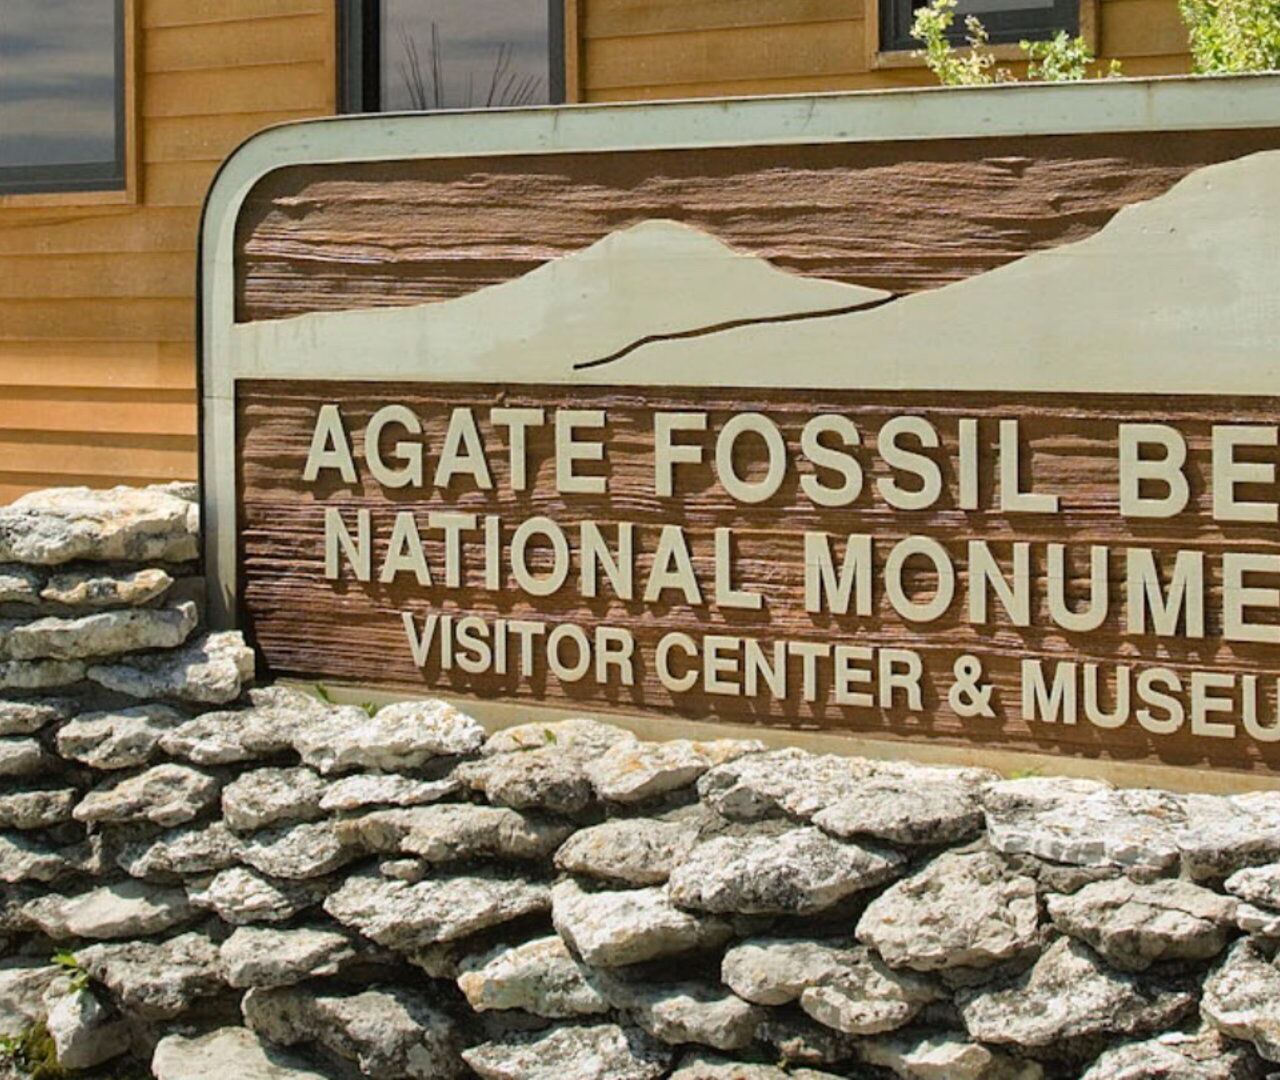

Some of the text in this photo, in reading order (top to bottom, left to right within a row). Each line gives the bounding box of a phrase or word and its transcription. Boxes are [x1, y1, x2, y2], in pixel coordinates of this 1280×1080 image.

[302, 404, 607, 495] AGATE
[653, 411, 1060, 514] FOSSIL
[323, 507, 763, 610] NATIONAL
[401, 611, 634, 687] VISITOR
[654, 631, 925, 713] CENTER
[947, 654, 997, 719] &
